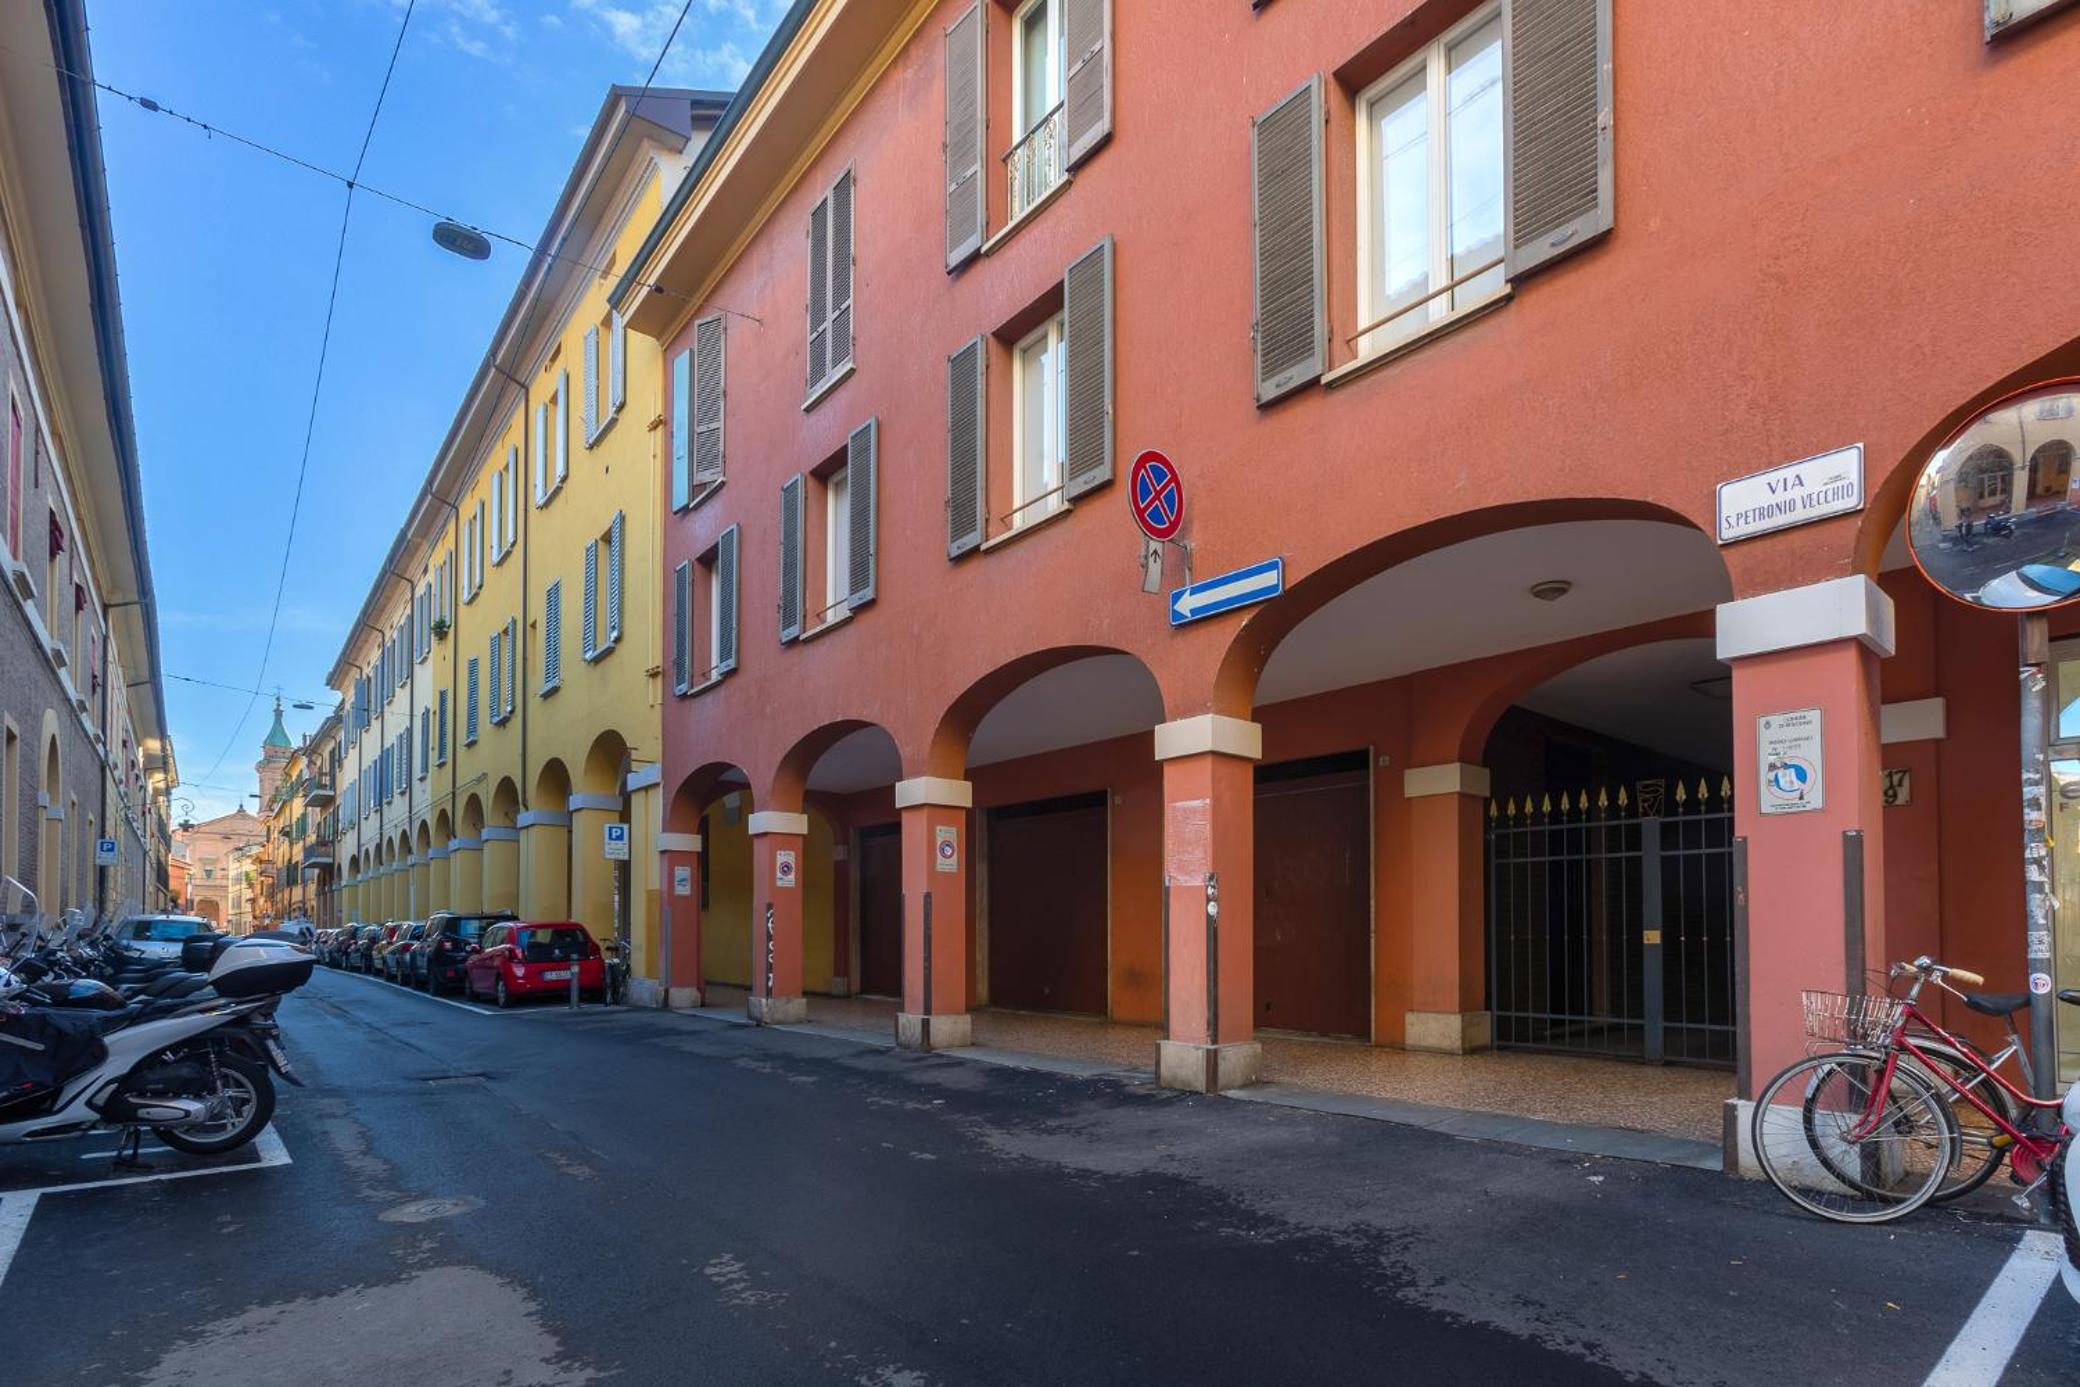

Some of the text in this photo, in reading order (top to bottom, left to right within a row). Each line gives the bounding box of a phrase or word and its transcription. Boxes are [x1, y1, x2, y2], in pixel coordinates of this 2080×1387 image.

[1766, 474, 1805, 495] VIA
[1801, 482, 1854, 510] VECCHIO
[1886, 770, 1908, 787] 17
